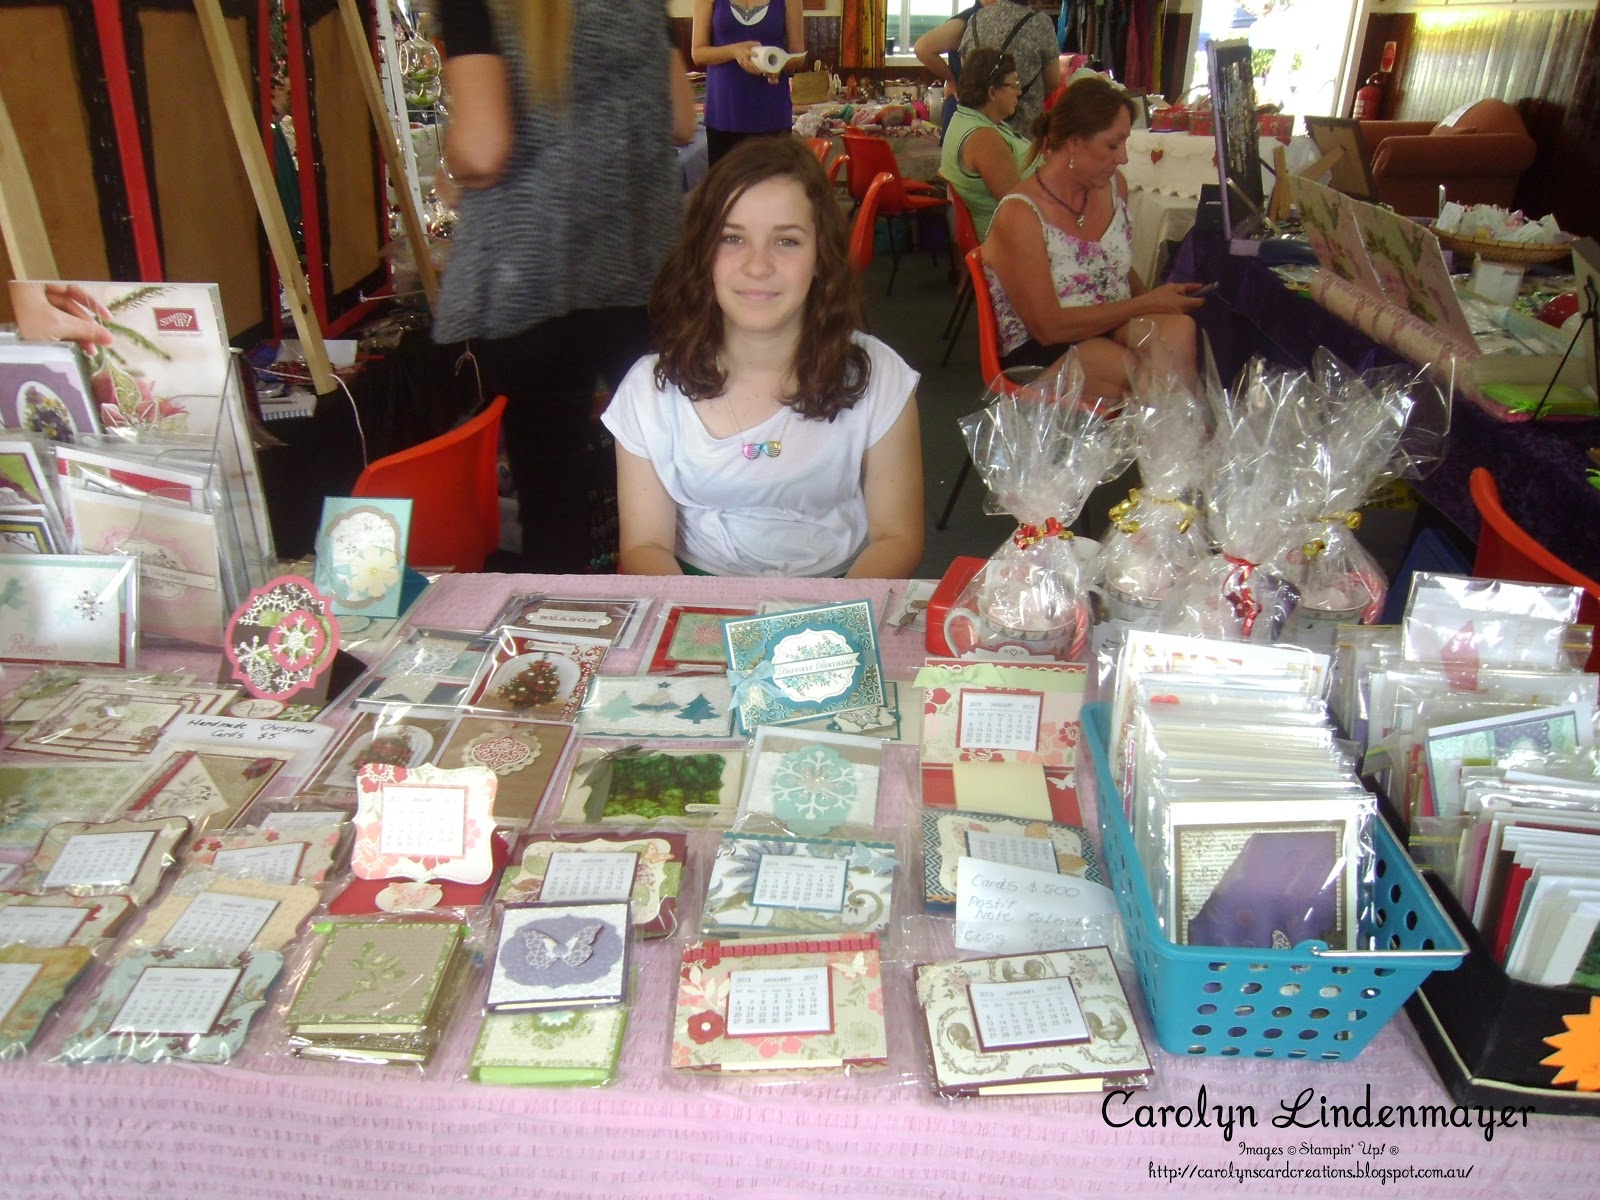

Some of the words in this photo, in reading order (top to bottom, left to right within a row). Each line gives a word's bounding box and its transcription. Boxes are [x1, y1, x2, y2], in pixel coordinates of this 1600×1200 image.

[188, 720, 248, 730] Handmade
[211, 729, 246, 740] Cards
[257, 732, 280, 740] $5
[971, 874, 1018, 892] Cards
